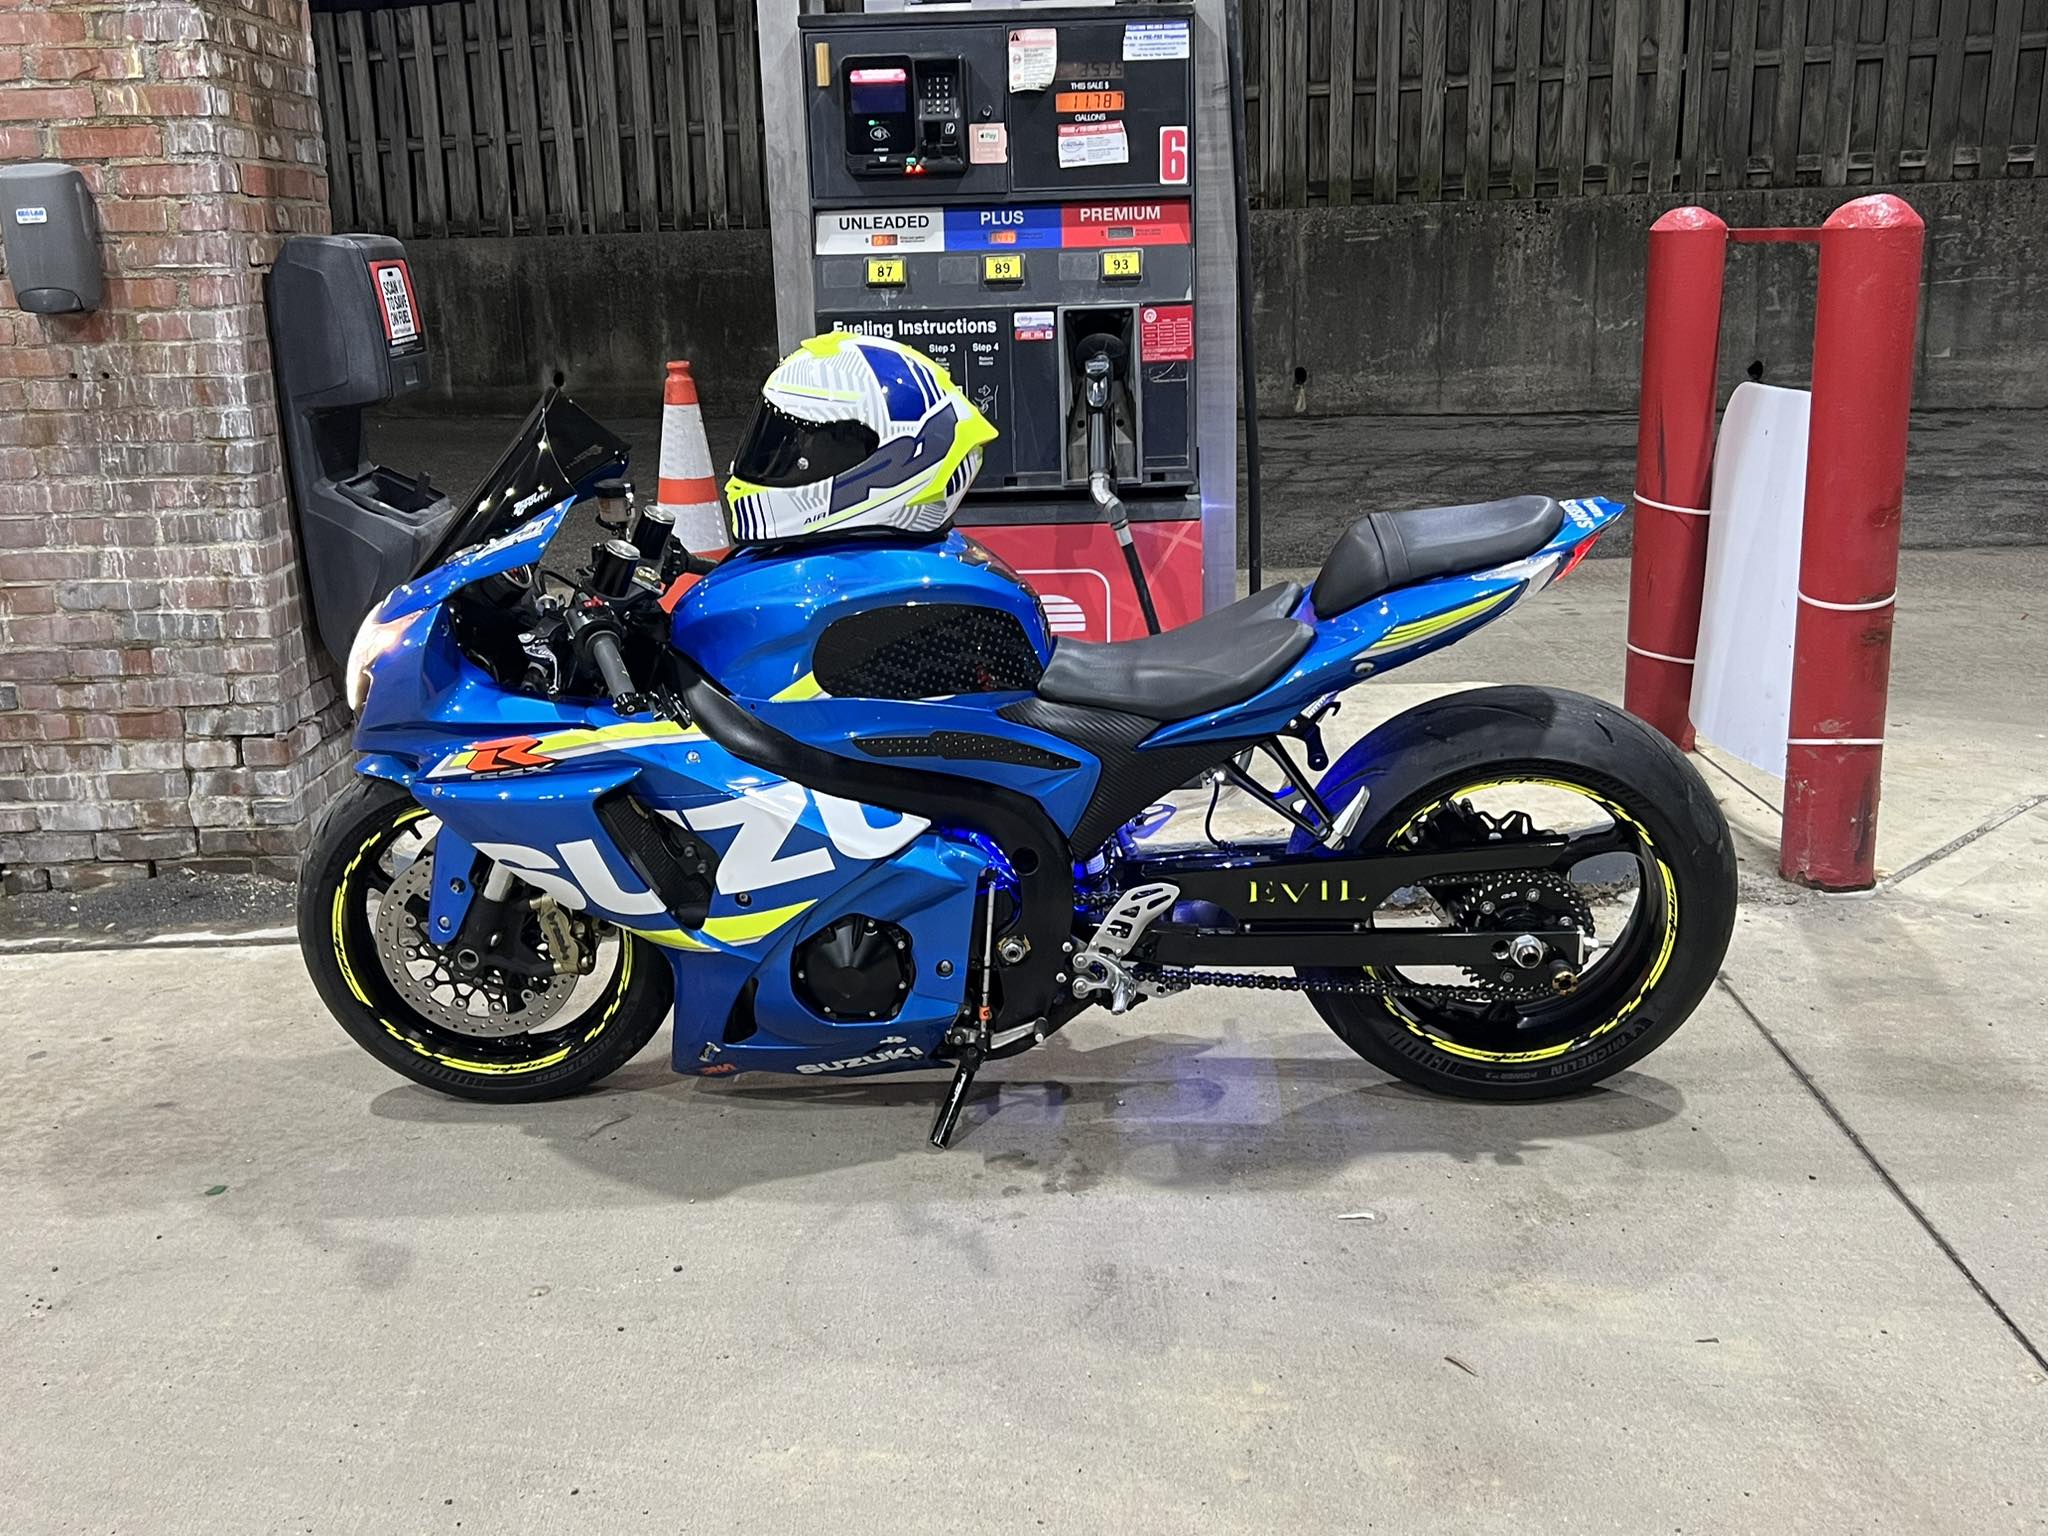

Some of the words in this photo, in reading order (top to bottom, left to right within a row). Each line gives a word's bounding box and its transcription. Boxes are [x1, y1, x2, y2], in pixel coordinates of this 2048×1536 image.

[1071, 82, 1086, 90] THIS
[1087, 81, 1104, 90] SALE
[1105, 81, 1109, 90] $
[1075, 113, 1106, 122] GALLONS
[1162, 130, 1186, 181] 6
[980, 210, 1024, 225] PLUS
[1080, 206, 1161, 222] PREMIUM
[839, 215, 930, 230] UNLEADED
[877, 266, 893, 277] 87
[995, 263, 1010, 274] 89
[1113, 259, 1129, 270] 93
[382, 279, 399, 295] SCAN
[394, 294, 408, 310] SAVE
[398, 310, 411, 325] FUEL
[833, 320, 894, 338] Fueling
[898, 318, 997, 335] Instructions
[929, 343, 949, 354] Step
[950, 343, 956, 352] 3
[972, 342, 992, 353] Step
[993, 342, 999, 351] 4
[471, 762, 553, 780] GSX
[1249, 879, 1367, 904] EVIL
[796, 1046, 924, 1075] SUZUKI
[1551, 1035, 1629, 1077] MICHELIN
